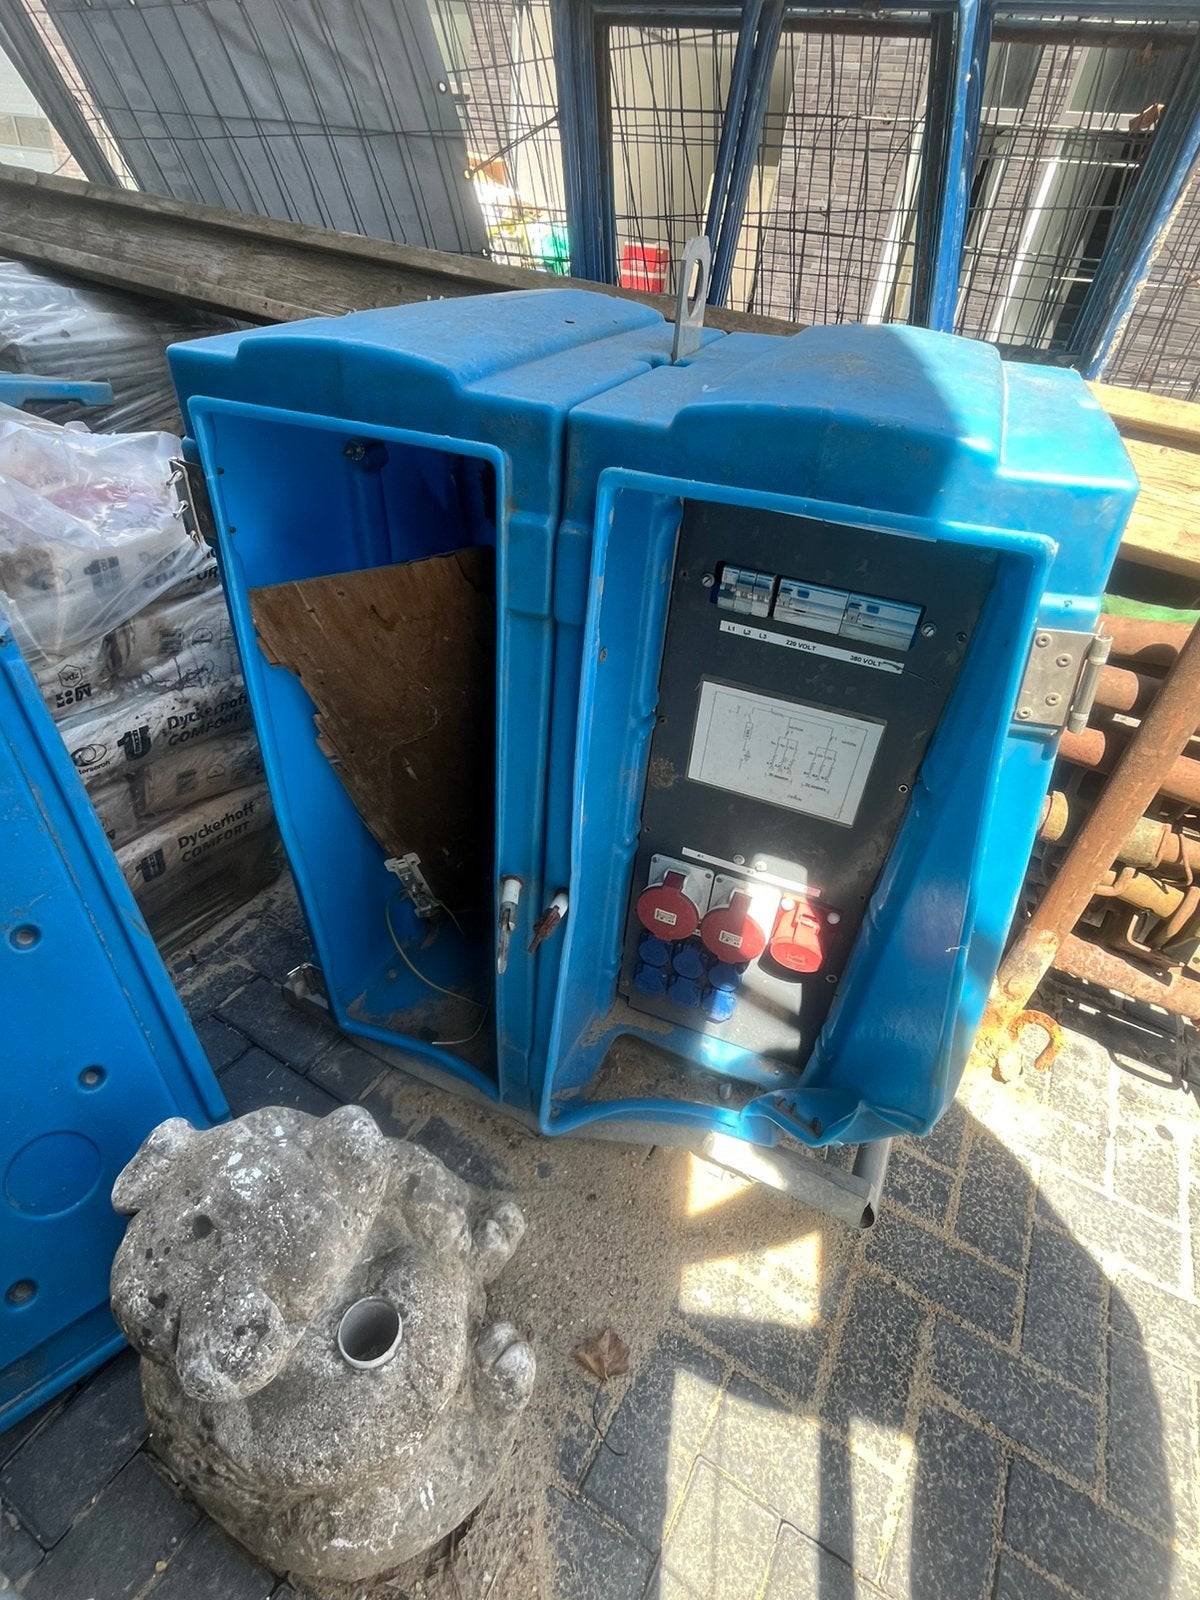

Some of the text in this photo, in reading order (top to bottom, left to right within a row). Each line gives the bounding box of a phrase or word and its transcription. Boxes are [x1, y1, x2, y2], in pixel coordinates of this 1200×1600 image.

[786, 639, 797, 647] 220
[798, 642, 817, 651] VOLT
[863, 658, 882, 667] VOLT
[177, 801, 256, 850] Dyckerhoff
[181, 821, 251, 863] COMFORT
